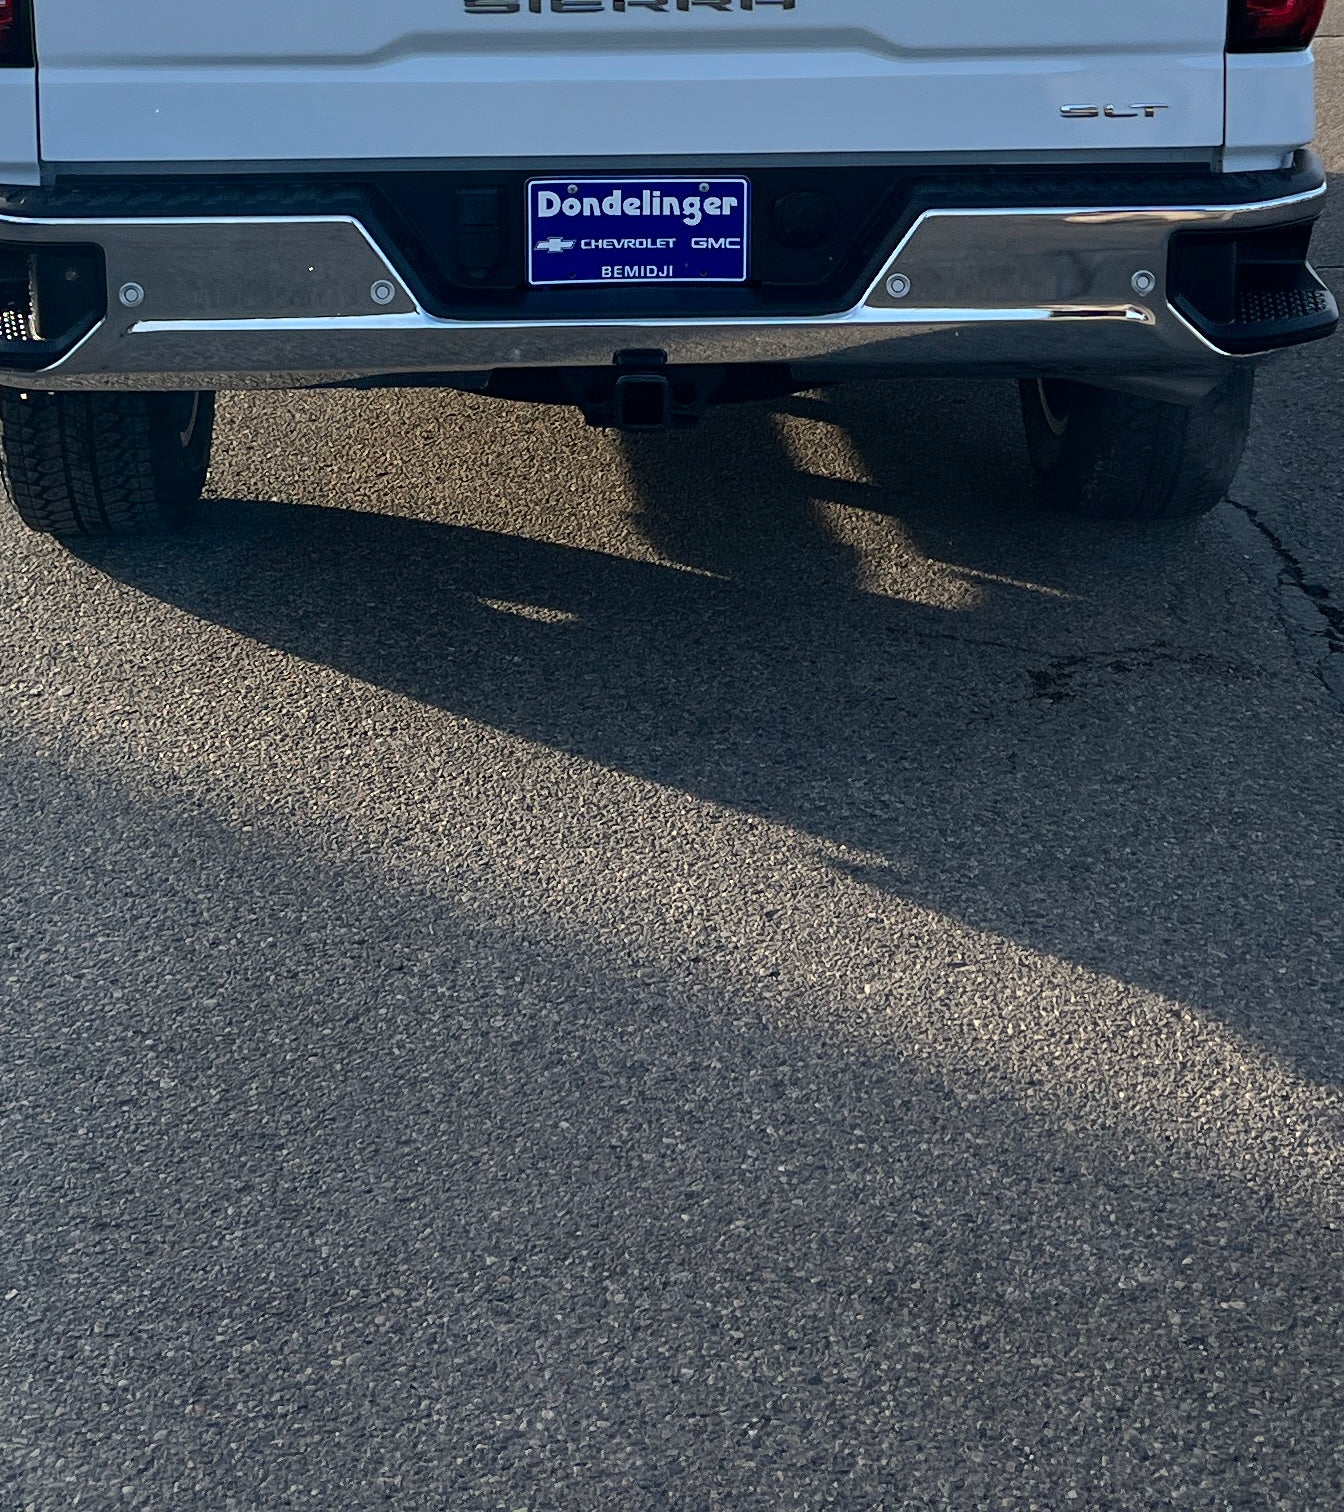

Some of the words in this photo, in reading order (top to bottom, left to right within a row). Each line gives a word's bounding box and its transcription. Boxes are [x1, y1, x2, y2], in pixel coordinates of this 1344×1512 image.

[1060, 103, 1169, 118] SLT
[537, 189, 738, 226] Dondelinger
[580, 238, 677, 250] CHEVROLET
[691, 238, 741, 249] GMC
[601, 265, 674, 278] BEMIDJI
